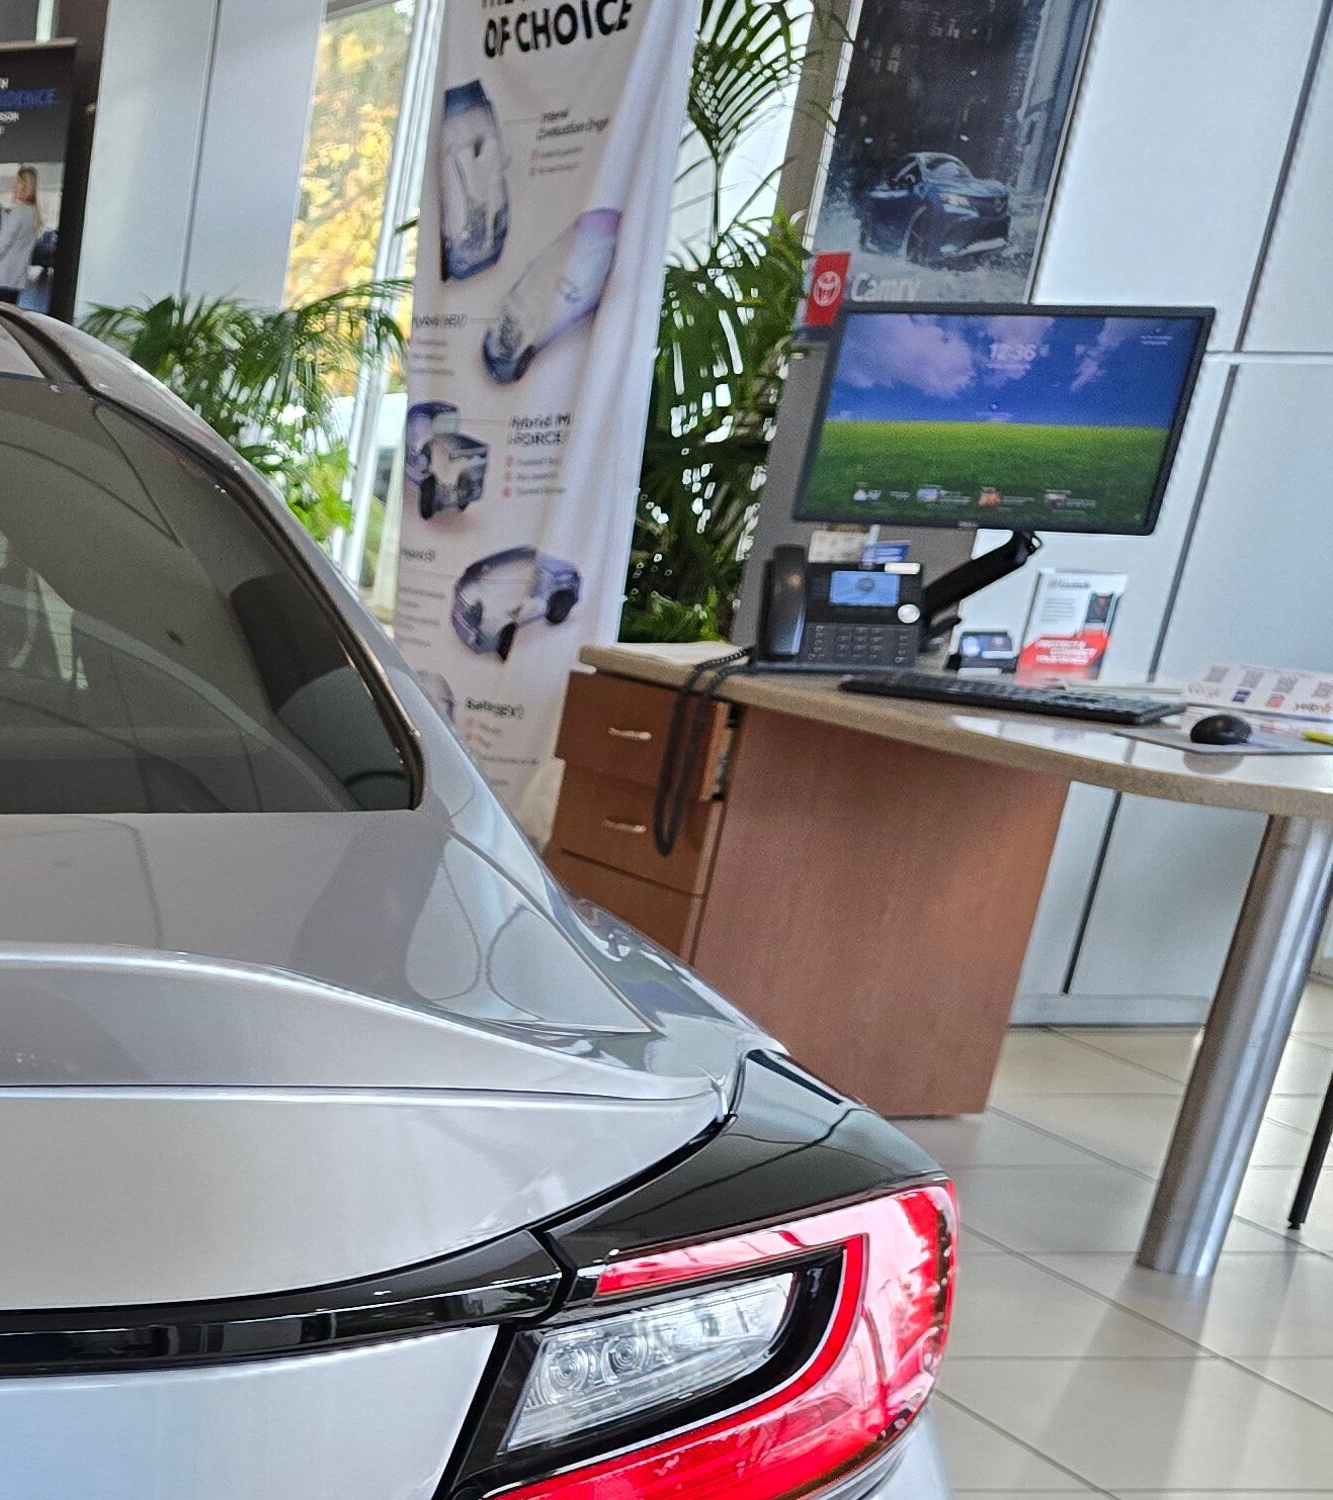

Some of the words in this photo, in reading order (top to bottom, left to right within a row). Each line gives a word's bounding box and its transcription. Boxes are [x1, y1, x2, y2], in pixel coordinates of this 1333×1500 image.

[484, 15, 512, 58] OF
[515, 0, 633, 52] CHOICE
[850, 272, 921, 301] Camry
